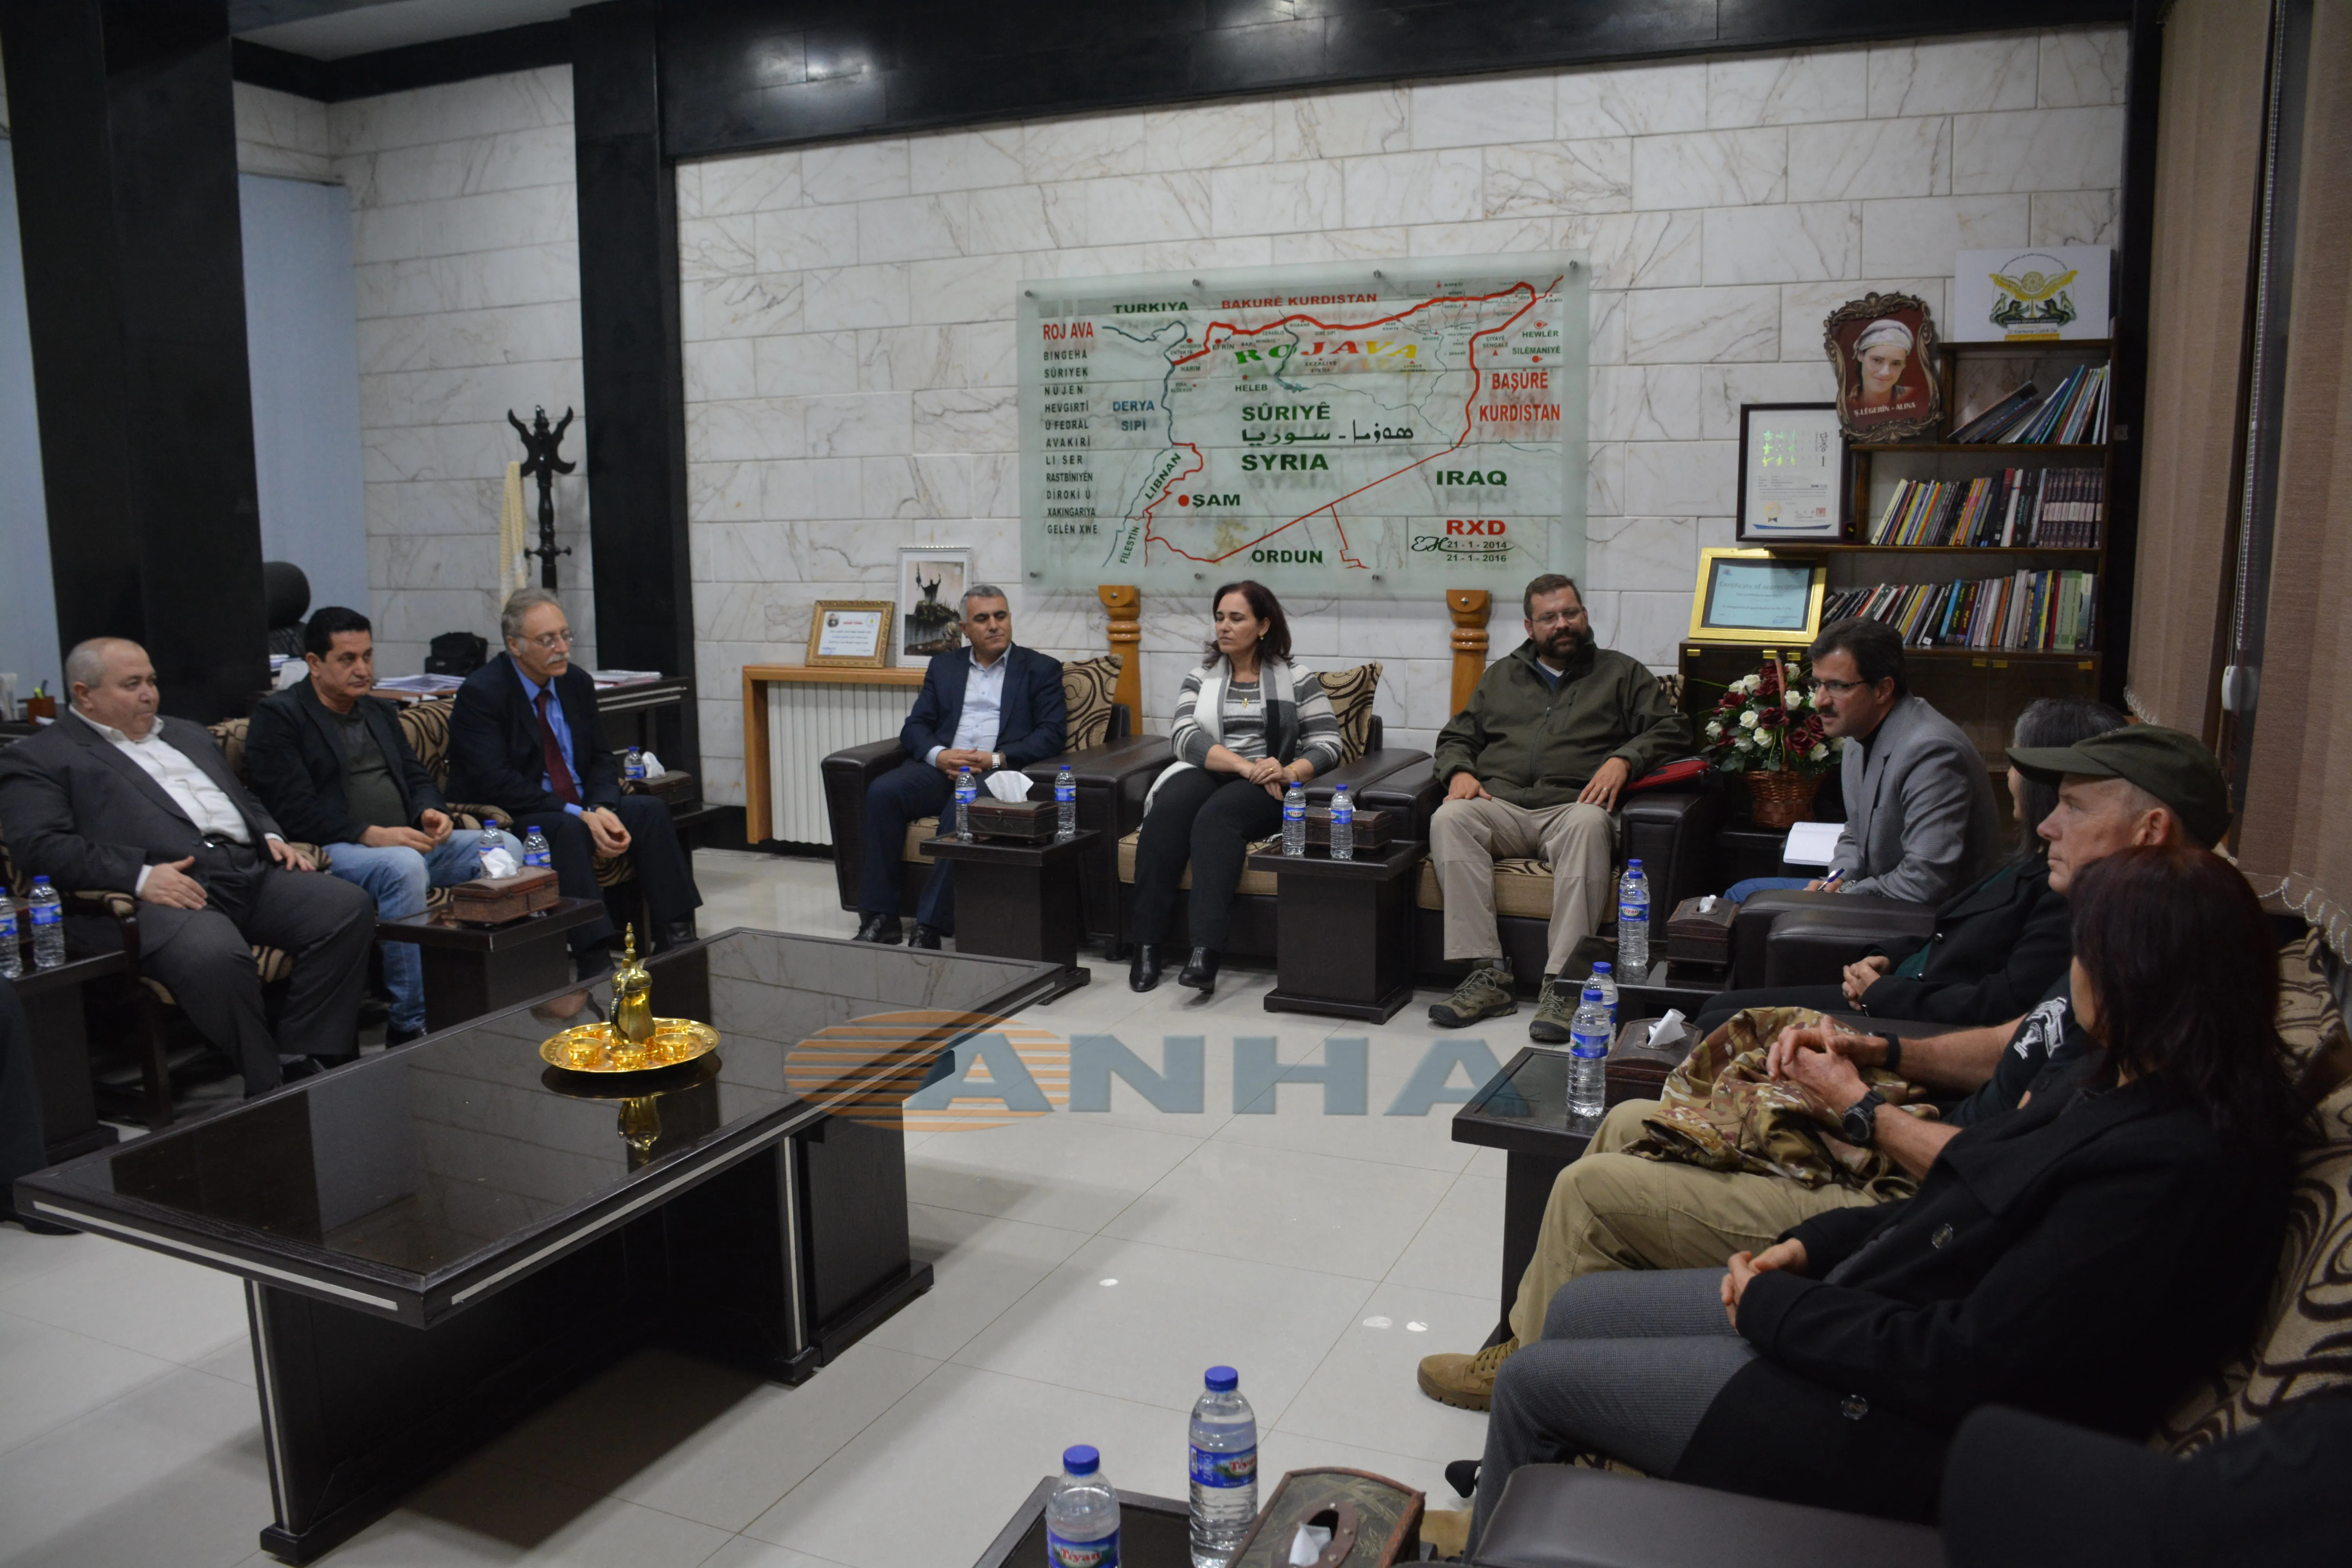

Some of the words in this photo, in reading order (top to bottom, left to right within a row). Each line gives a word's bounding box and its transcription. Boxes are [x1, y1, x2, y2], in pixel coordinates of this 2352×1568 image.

[1113, 302, 1189, 314] TURKIYA
[1222, 296, 1283, 309] BAKURÊ
[1289, 294, 1376, 305] KURDISTAN
[1044, 323, 1065, 340] ROJ
[1071, 322, 1094, 339] AVA
[1044, 350, 1087, 361] BINGEHA
[1044, 367, 1088, 378] SÛRIYEK
[1492, 368, 1548, 393] BAŞÛRÊ
[1113, 401, 1155, 412] DERYA
[1242, 402, 1330, 421] SÛRIYÊ
[1480, 404, 1560, 422] KURDISTAN
[1896, 402, 1916, 410] ALINA
[1054, 419, 1089, 430] FEDRAL
[1241, 429, 1331, 446] سوريا
[1062, 455, 1083, 465] SER
[1241, 454, 1329, 471] SYRIA
[1145, 453, 1181, 500] LIBNAN
[1437, 470, 1507, 486] IRAQ
[1192, 494, 1240, 508] ŞAM
[1079, 524, 1098, 534] XWE
[1446, 520, 1506, 535] RXD
[1252, 550, 1323, 564] ORDUN
[1762, 583, 1802, 592] appreciation
